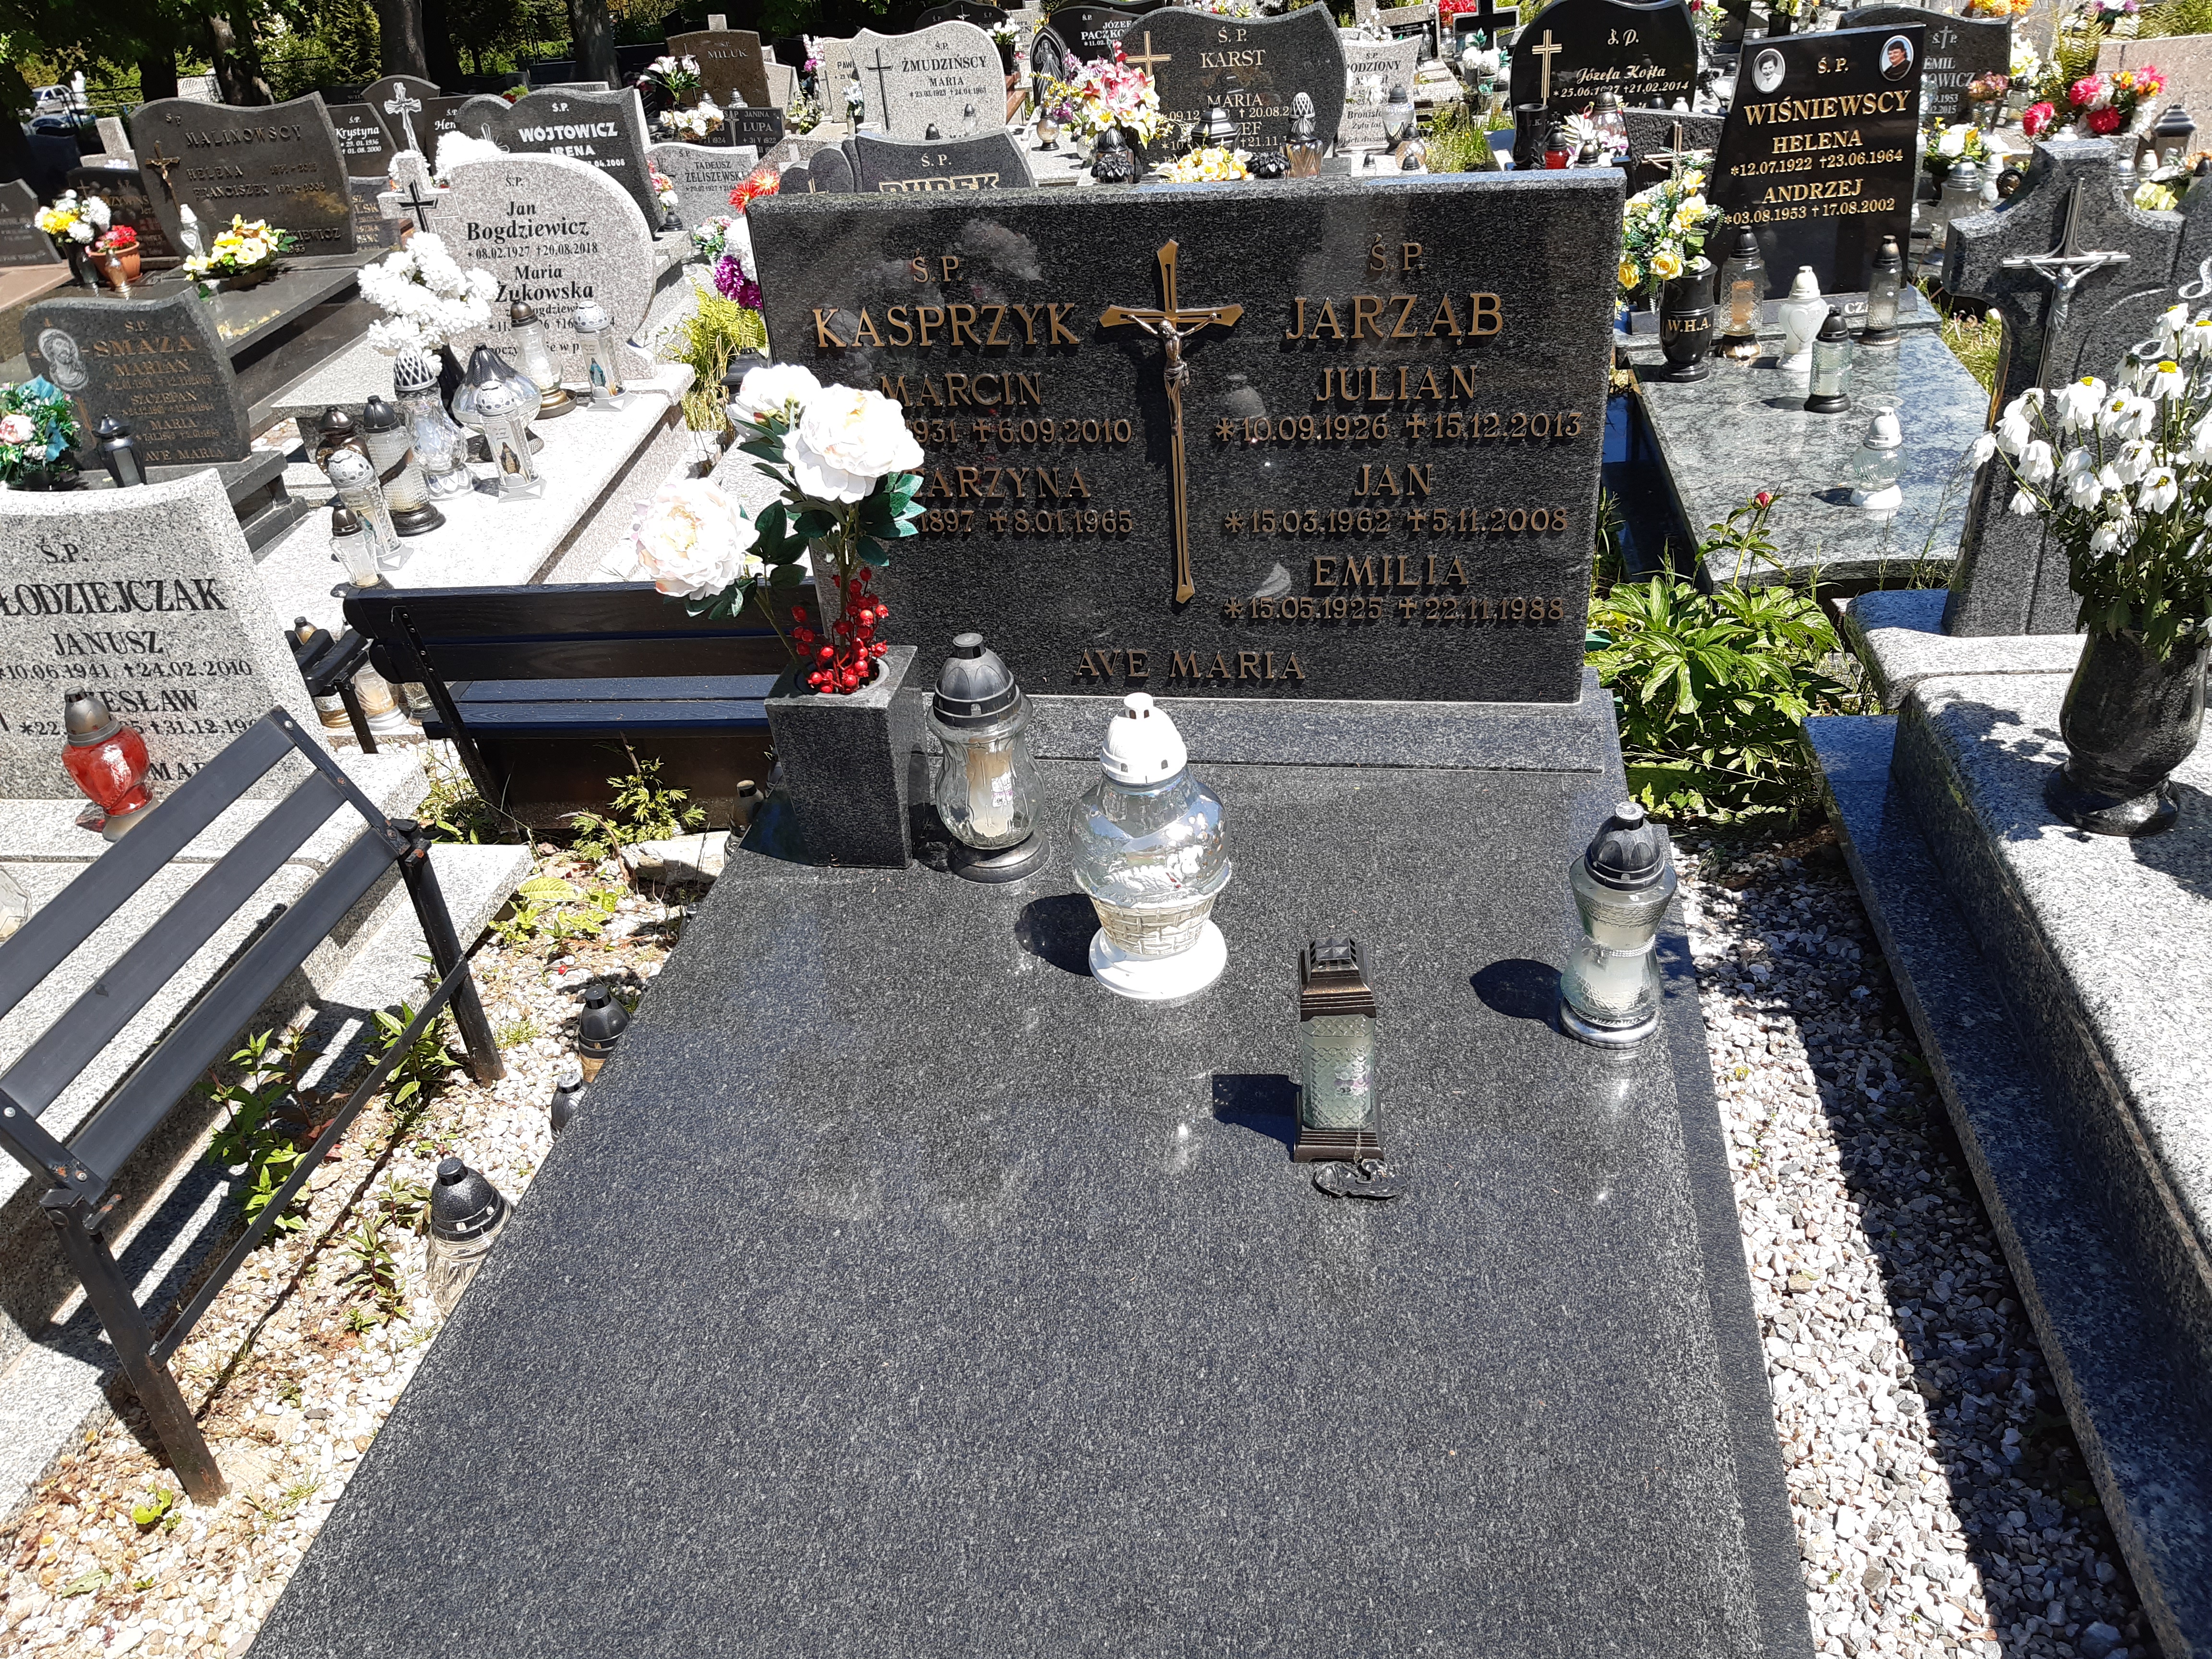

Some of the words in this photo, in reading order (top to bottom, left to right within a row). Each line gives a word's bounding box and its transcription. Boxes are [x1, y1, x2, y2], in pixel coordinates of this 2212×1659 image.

[1103, 20, 1132, 29] JÓZEF
[707, 48, 749, 59] MILUK
[902, 54, 986, 72] ŻMUDZIŃSCY
[1200, 49, 1266, 68] KARST
[1923, 57, 1956, 70] EMIL
[929, 77, 964, 86] MARIA
[1576, 66, 1621, 84] Józefa
[1624, 64, 1667, 80] Kojta
[1207, 93, 1262, 108] MARIA
[1743, 89, 1911, 125] WIŚNIEWSCY
[185, 125, 301, 145] MALINOWSCY
[336, 126, 380, 141] Krystyna
[518, 122, 619, 143] WÓJTOWICZ
[743, 122, 773, 132] LUPA
[550, 145, 596, 157] IRENA
[1772, 129, 1863, 154] HELENA
[186, 165, 243, 180] HELENA
[694, 161, 732, 169] TADEUSZ
[1761, 179, 1864, 204] ANDRZEJ
[506, 201, 536, 216] Jan
[467, 217, 589, 244] Bogdziewicz
[515, 264, 563, 280] Maria
[494, 281, 594, 302] Żukowska
[812, 303, 1081, 349] KASPRZYK
[1286, 293, 1503, 345] JARZĄB
[113, 359, 191, 377] MARIAN
[879, 372, 1042, 407] MARCIN
[1316, 365, 1477, 402] JULIAN
[131, 391, 197, 405] SZCZEPAN
[149, 418, 197, 430] MARIA
[145, 449, 172, 461] AVE
[177, 447, 225, 459] MARIA
[1355, 463, 1433, 496] JAN
[1314, 555, 1468, 587] EMILIA
[0, 578, 228, 616] ŁODZIEJCZAK
[51, 631, 164, 656] JANUSZ
[1075, 649, 1150, 677] AVE
[1170, 649, 1306, 680] MARIA
